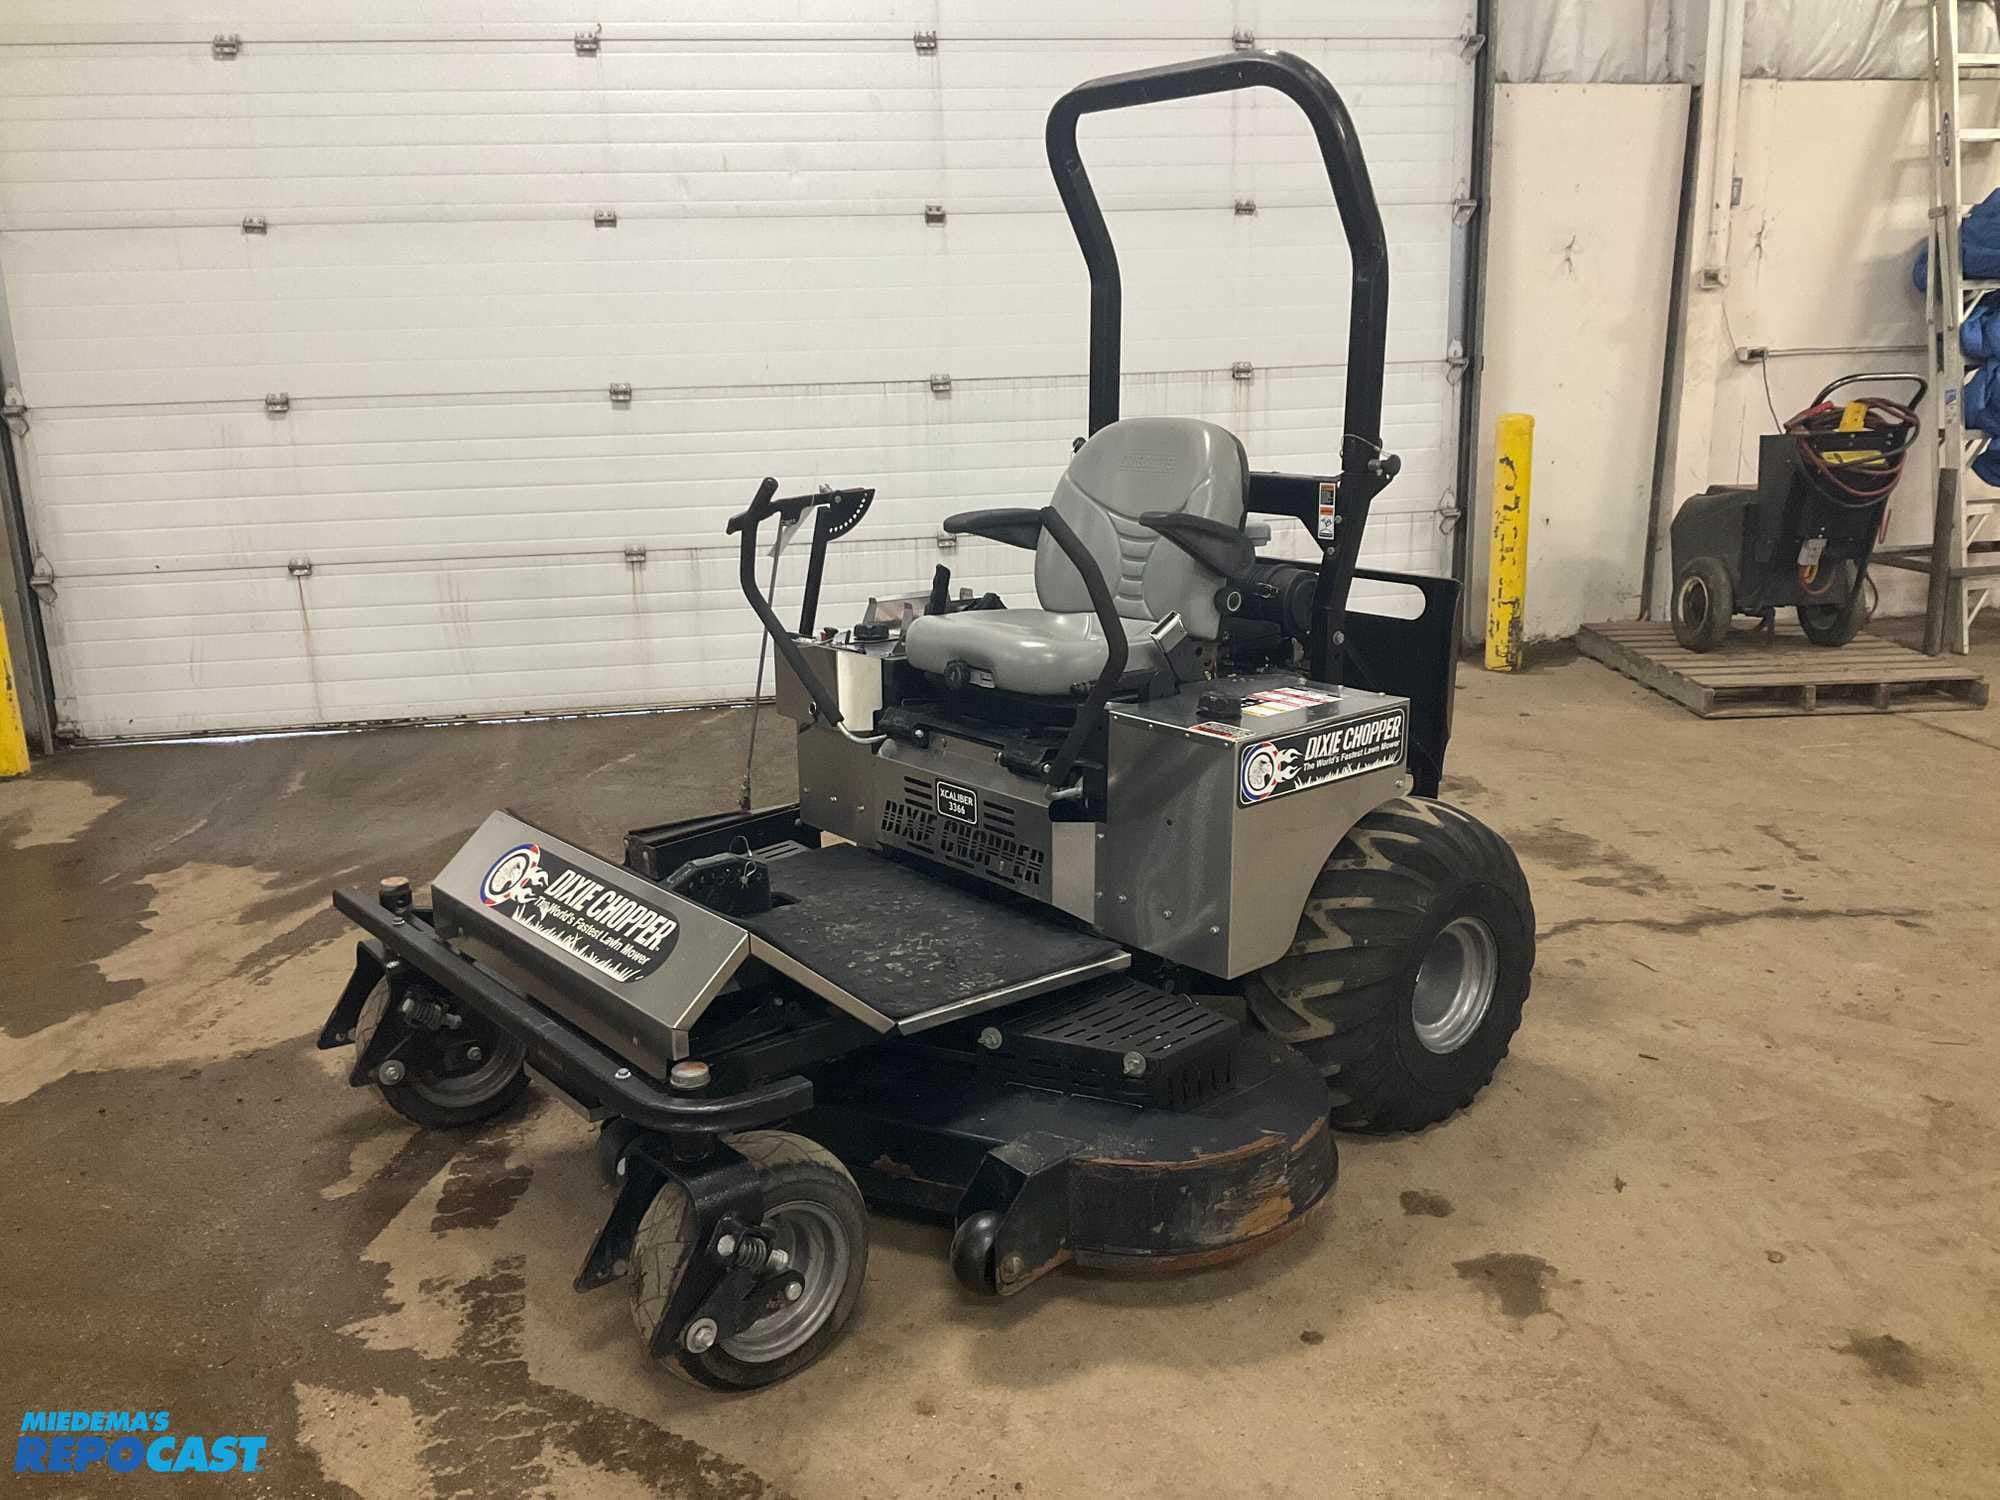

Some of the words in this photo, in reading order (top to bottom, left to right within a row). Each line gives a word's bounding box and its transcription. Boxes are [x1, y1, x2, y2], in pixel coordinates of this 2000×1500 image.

[1303, 761, 1315, 771] The
[1316, 755, 1340, 768] World's
[1340, 749, 1363, 761] Fastest
[1363, 745, 1380, 755] Lawn
[1380, 740, 1400, 751] Mower
[1304, 730, 1343, 761] DIXIE
[1343, 715, 1401, 750] CHOPPER
[940, 788, 973, 806] XCALIBER
[544, 869, 604, 911] DIXIE
[586, 890, 677, 951] CHOPPER
[548, 903, 575, 924] World's
[572, 918, 602, 940] Fastest
[599, 931, 623, 951] Lawn
[620, 943, 651, 965] Mower
